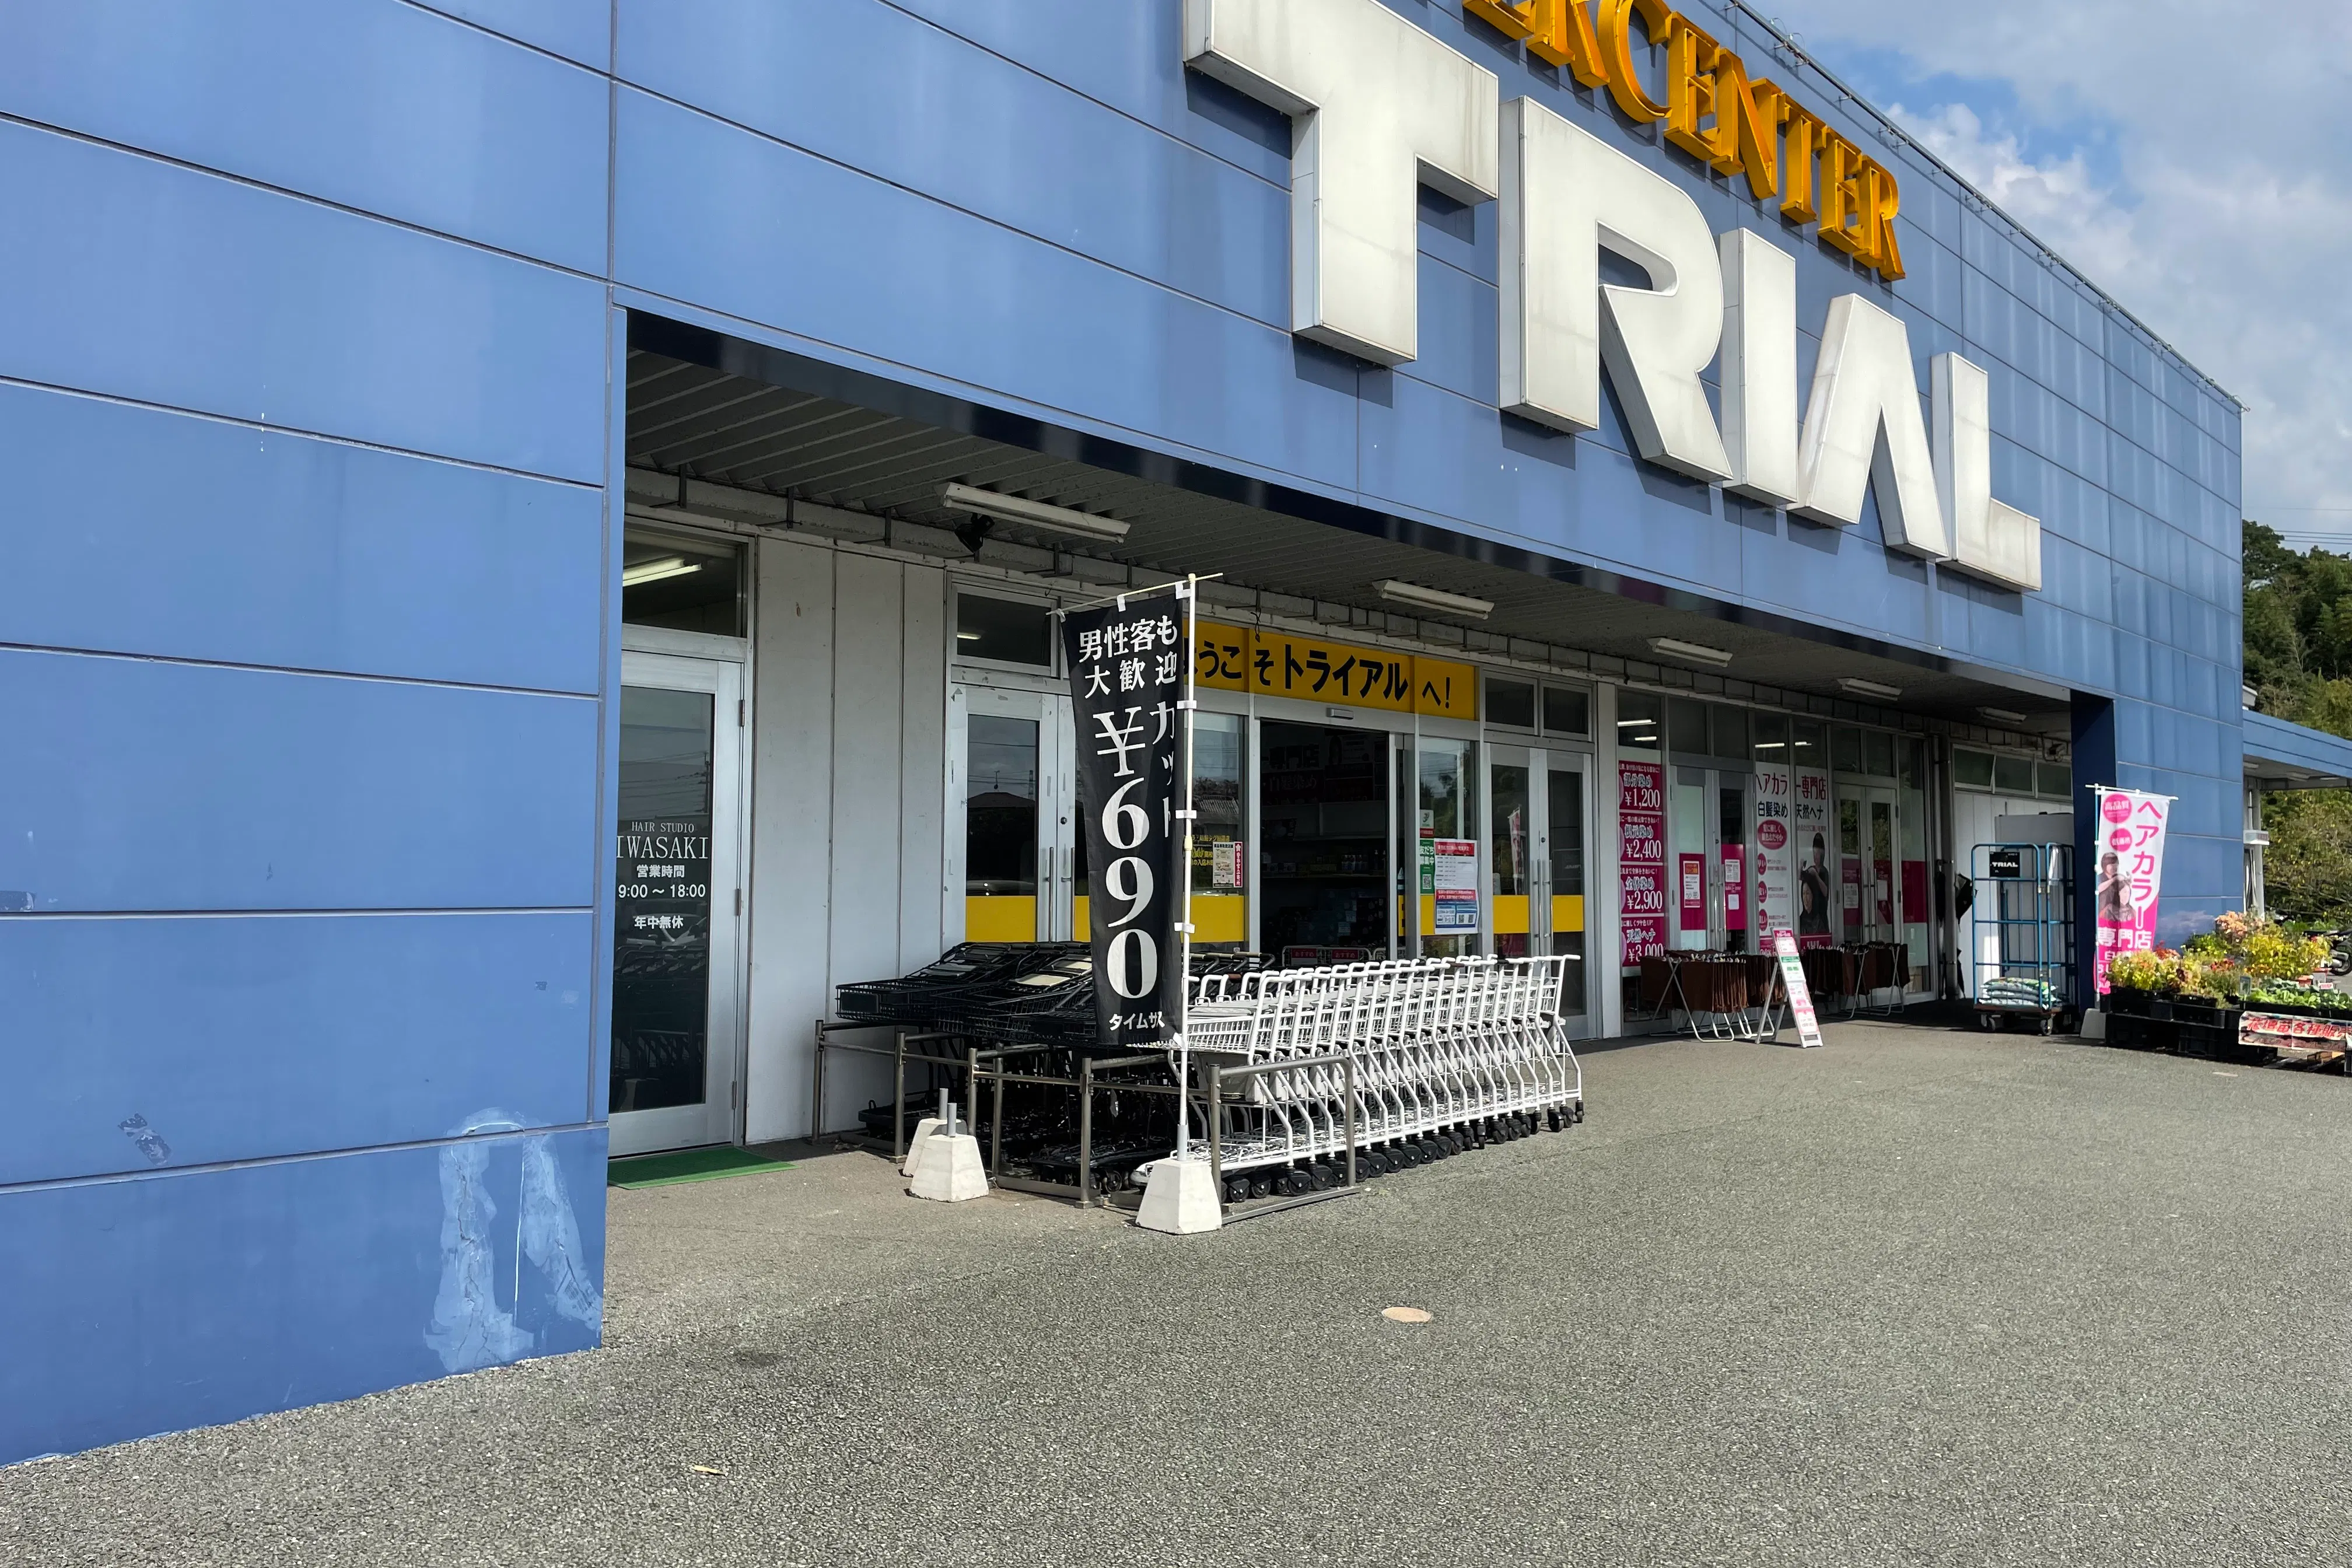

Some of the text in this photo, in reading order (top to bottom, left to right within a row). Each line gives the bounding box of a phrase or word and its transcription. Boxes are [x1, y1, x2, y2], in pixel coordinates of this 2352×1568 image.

[1461, 0, 1906, 281] CENTER
[1183, 0, 2042, 592] TRIAL
[1079, 615, 1178, 663] 男性客も
[1084, 651, 1177, 699] 大歓迎
[1625, 788, 1660, 810] ¥1,200
[1758, 800, 1824, 820] 白髪染め 天然ヘナ
[632, 821, 695, 834] HAIR STUDIO
[616, 835, 709, 859] IWASAKI
[1093, 706, 1158, 999] ¥690
[1626, 839, 1662, 862] ¥2,400
[636, 864, 685, 878] 営業時間
[2132, 801, 2162, 928] ヘアカラー
[1627, 890, 1663, 913] ¥2,900
[634, 915, 684, 929] 年中無休
[2098, 926, 2152, 949] 専門店
